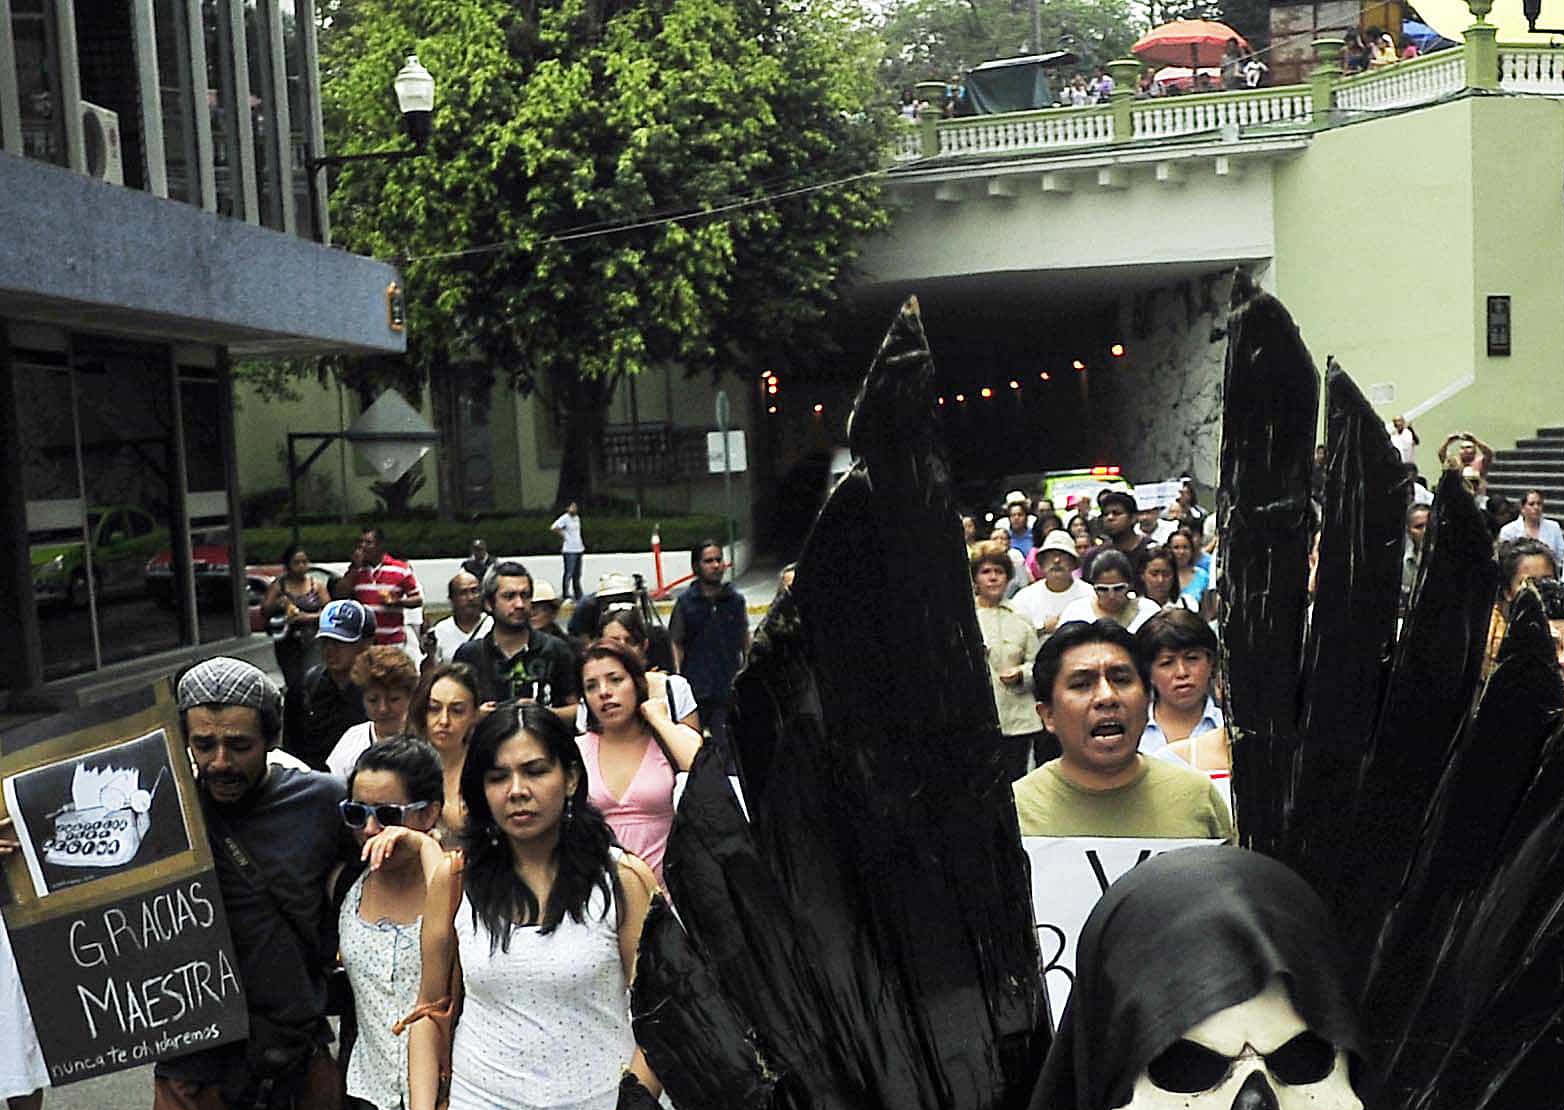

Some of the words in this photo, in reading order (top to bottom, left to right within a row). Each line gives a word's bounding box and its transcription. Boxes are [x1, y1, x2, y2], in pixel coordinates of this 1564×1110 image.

[69, 881, 214, 968] GRACIAS
[77, 949, 240, 1040] MAESTRA
[51, 1053, 105, 1077] nunca
[107, 1044, 128, 1065] te
